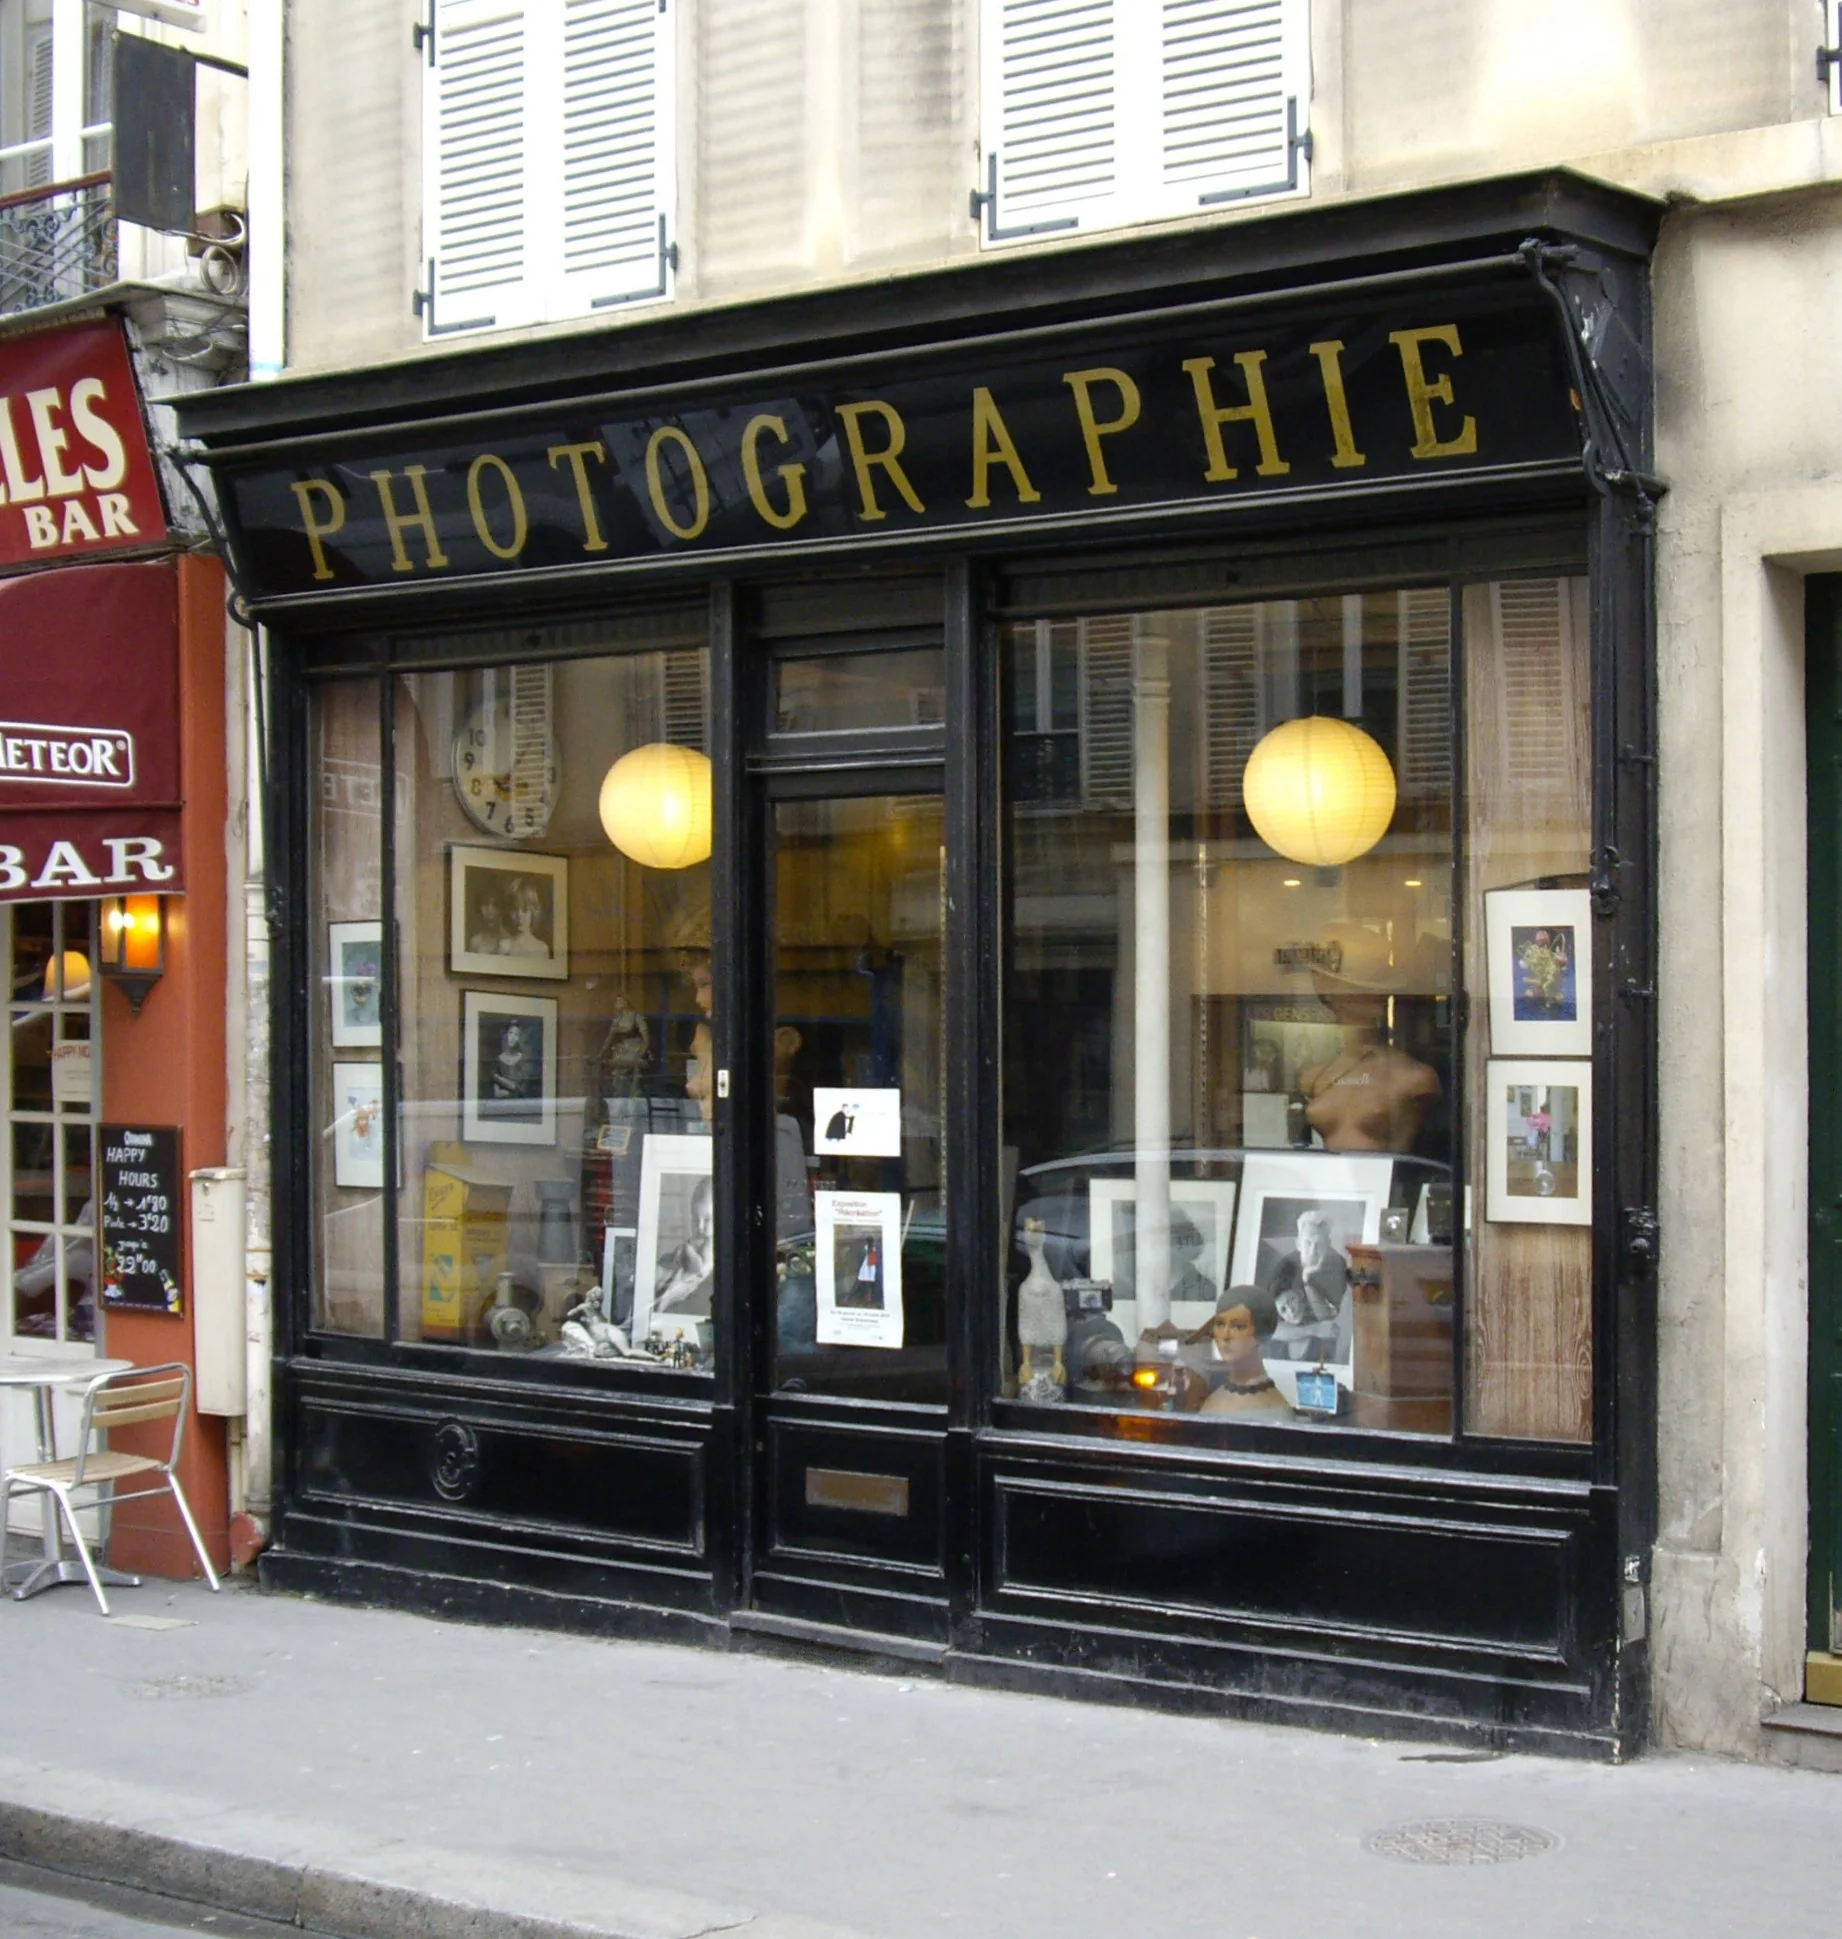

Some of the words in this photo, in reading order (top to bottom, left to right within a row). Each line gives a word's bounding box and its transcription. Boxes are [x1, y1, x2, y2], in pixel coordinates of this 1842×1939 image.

[0, 377, 126, 504] LES
[290, 323, 1479, 581] PHOTOGRAPHIE
[22, 493, 140, 549] BAR
[0, 836, 175, 889] BAR
[106, 1147, 146, 1163] HAPPY
[118, 1171, 159, 1188] HOURS
